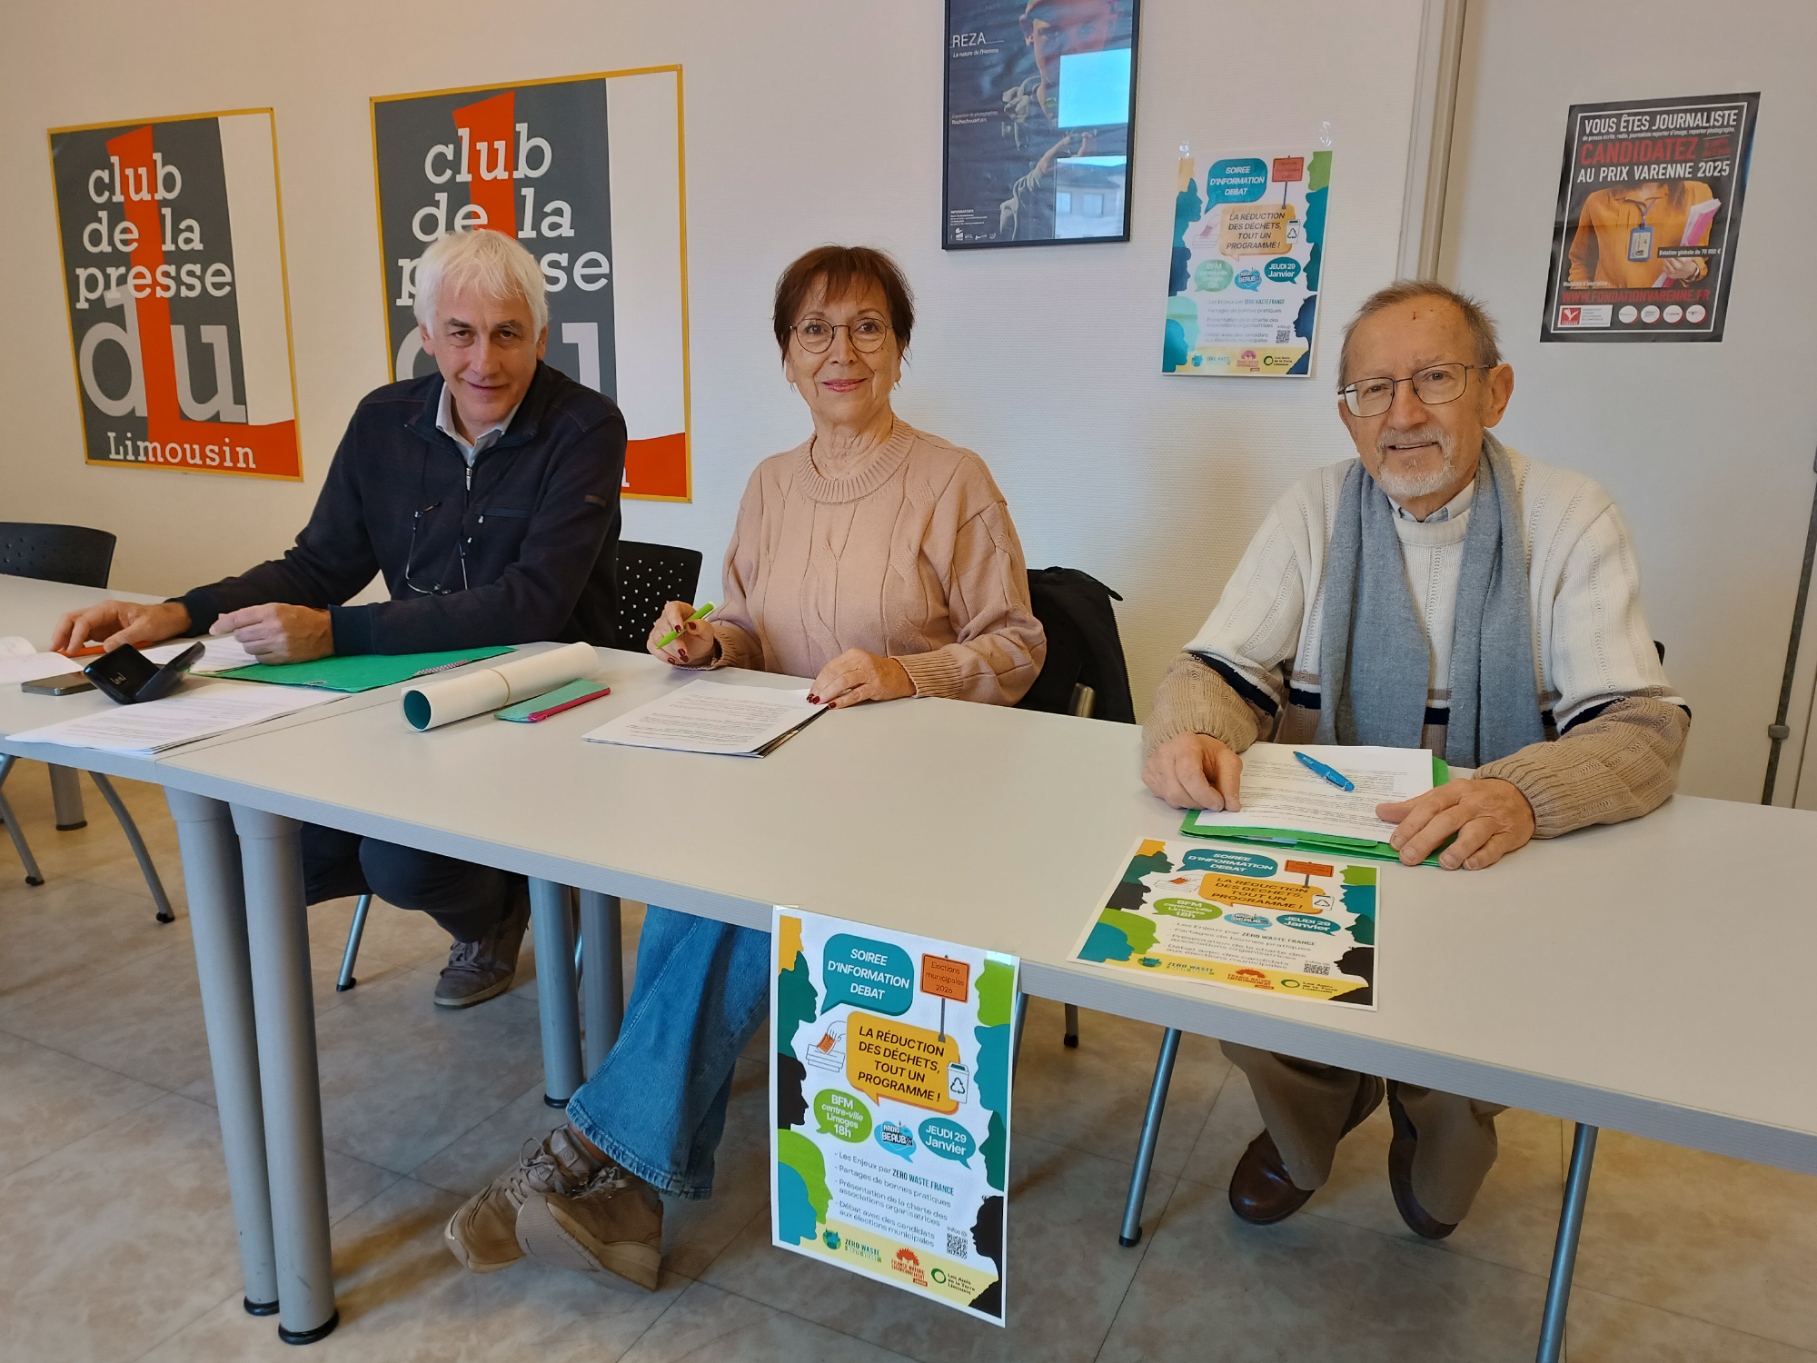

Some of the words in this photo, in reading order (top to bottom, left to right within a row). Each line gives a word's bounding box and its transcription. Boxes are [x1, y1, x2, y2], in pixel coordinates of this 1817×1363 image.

[952, 32, 986, 48] REZA
[1584, 117, 1617, 134] VOUS
[1620, 114, 1650, 132] ÊTES
[1652, 109, 1739, 130] JOURNALISTE
[424, 122, 553, 184] club
[1580, 137, 1699, 165] CANDIDATEZ
[88, 152, 182, 204] club
[1225, 165, 1251, 174] SOIREE
[1577, 168, 1596, 183] AU
[1599, 166, 1629, 182] PRIX
[1634, 163, 1694, 180] VARENNE
[1697, 160, 1731, 177] 2025
[1210, 176, 1265, 186] D'INFORMATION
[1224, 188, 1248, 196] DEBAT
[412, 192, 488, 242] de
[517, 187, 575, 239] la
[1240, 212, 1286, 220] RÉDUCTION
[83, 210, 139, 253] de
[161, 207, 203, 251] la
[1244, 221, 1282, 230] DÉCHETS,
[1238, 232, 1259, 240] TOUT
[1226, 242, 1277, 250] PROGRAMME
[395, 251, 610, 306] pse
[1267, 270, 1296, 278] Janvier
[75, 262, 233, 309] presse
[79, 284, 247, 423] du
[107, 431, 257, 469] Limousin
[1188, 855, 1274, 871] D'INFORMATION
[1212, 853, 1253, 862] SOIREE
[1210, 863, 1248, 873] DEBAT
[1214, 882, 1241, 890] DES
[1231, 890, 1268, 898] TOUT
[1211, 893, 1296, 909] PROGRAMME
[1283, 921, 1331, 932] Janvier
[1284, 916, 1316, 925] JEUDI
[850, 948, 888, 966] SOIREE
[827, 960, 910, 989] D'INFORMATION
[925, 972, 964, 987] municipales
[850, 982, 885, 1000] DEBAT
[935, 984, 953, 994] 2026
[859, 1025, 874, 1039] LA
[876, 1030, 945, 1057] RÉDUCTION
[858, 1041, 881, 1055] DES
[883, 1048, 940, 1074] DÉCHETS,
[874, 1060, 907, 1077] TOUT
[908, 1070, 925, 1083] UN
[858, 1071, 935, 1101] PROGRAMME
[831, 1094, 854, 1109] BFM
[821, 1103, 864, 1121] centre-ville
[826, 1112, 859, 1129] Limoges
[833, 1123, 852, 1138] 18h
[926, 1125, 954, 1140] JEUDI
[954, 1132, 967, 1144] 29
[925, 1135, 967, 1156] Janvier
[839, 1151, 852, 1161] Les
[853, 1155, 877, 1170] Enjeux
[878, 1165, 891, 1175] par
[892, 1168, 908, 1181] ZERO
[908, 1173, 930, 1188] WASTE
[930, 1180, 955, 1196] FRANCE
[839, 1165, 872, 1182] Partages
[872, 1176, 883, 1185] de
[884, 1179, 913, 1195] bonnes
[913, 1190, 952, 1208] pratiques
[839, 1178, 886, 1201] Présentation
[887, 1195, 897, 1204] de
[906, 1201, 932, 1215] charte
[933, 1210, 948, 1221] des
[839, 1188, 884, 1208] associations
[885, 1203, 940, 1227] organisatrices
[839, 1200, 861, 1213] Débat
[863, 1210, 881, 1221] avec
[881, 1215, 896, 1226] des
[896, 1221, 935, 1240] candidats
[839, 1209, 852, 1218] aux
[853, 1212, 887, 1232] élections
[888, 1225, 935, 1248] municipales
